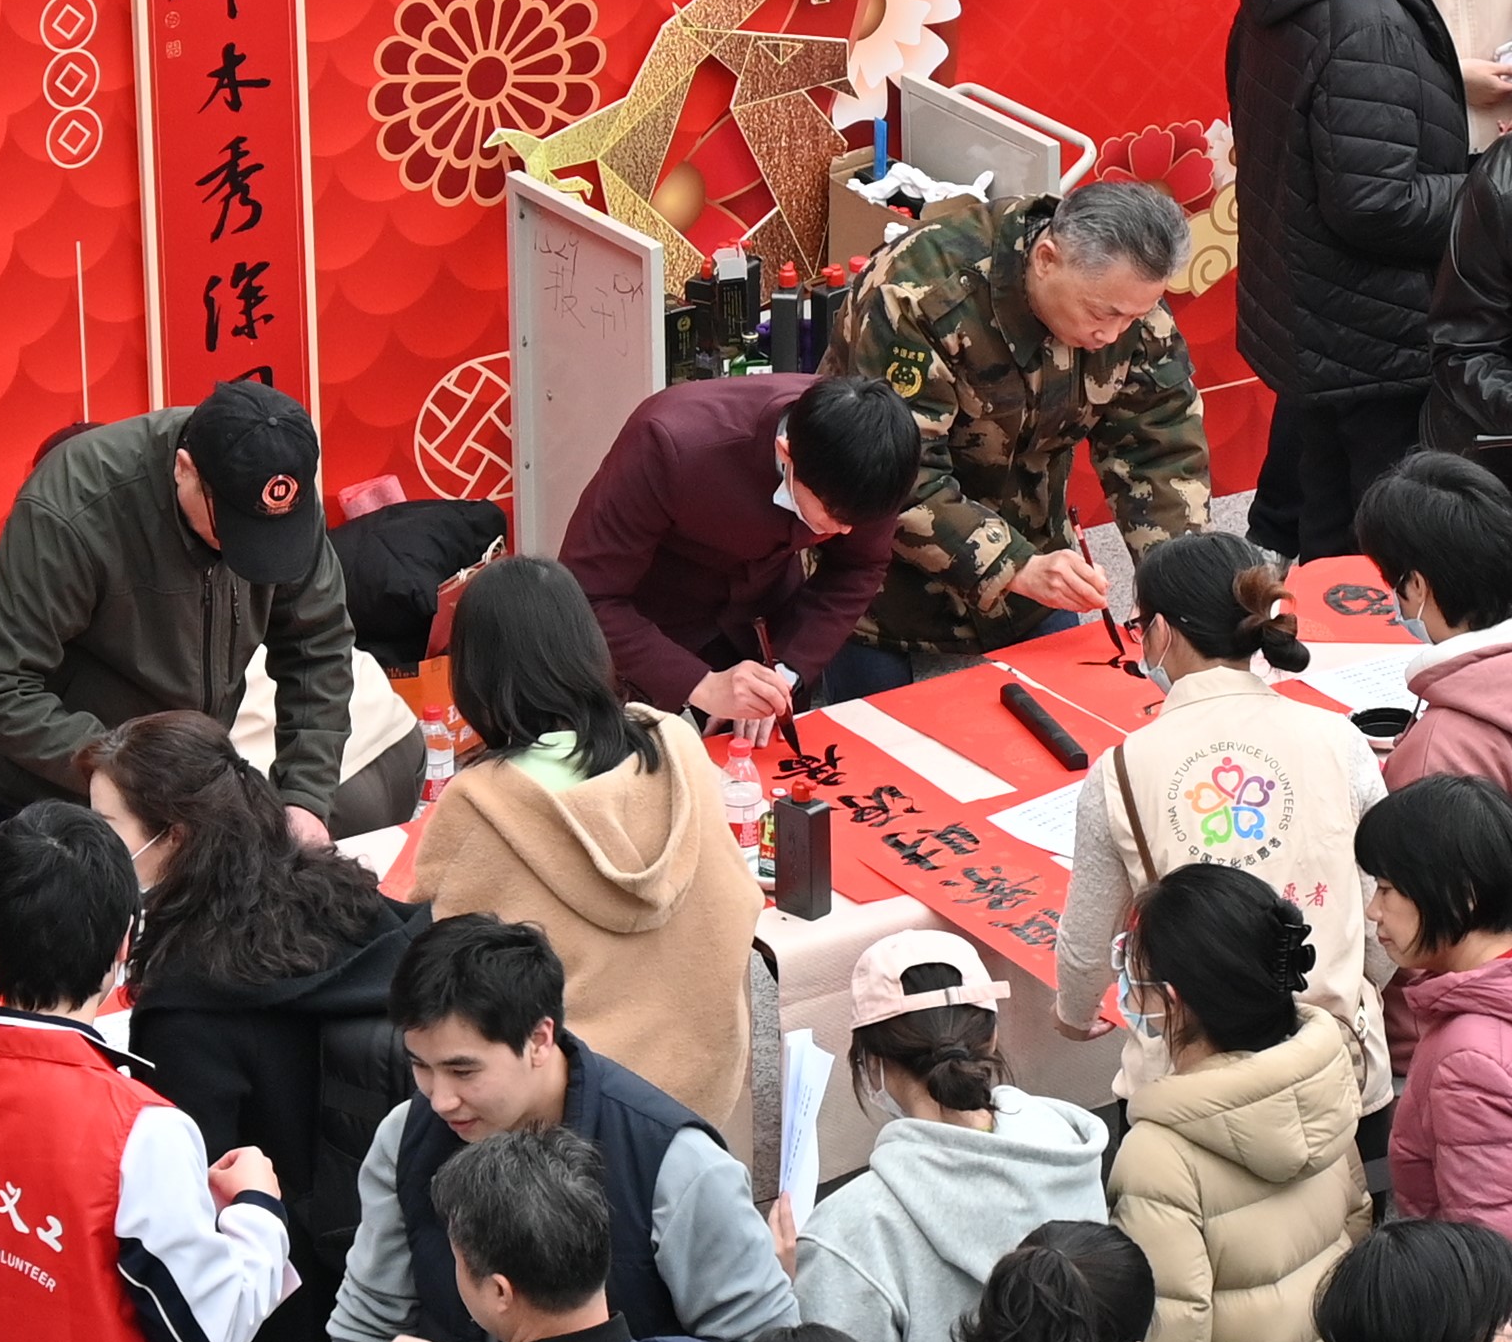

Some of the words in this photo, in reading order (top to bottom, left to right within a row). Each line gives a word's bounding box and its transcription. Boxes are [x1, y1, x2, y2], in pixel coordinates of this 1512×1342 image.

[1209, 741, 1263, 759] SERVICE
[1167, 748, 1208, 801] CULTURAL
[1264, 753, 1294, 832] VOLUNTEERS
[1167, 805, 1187, 842] CHINA
[1187, 837, 1282, 869] 中国文化志愿者
